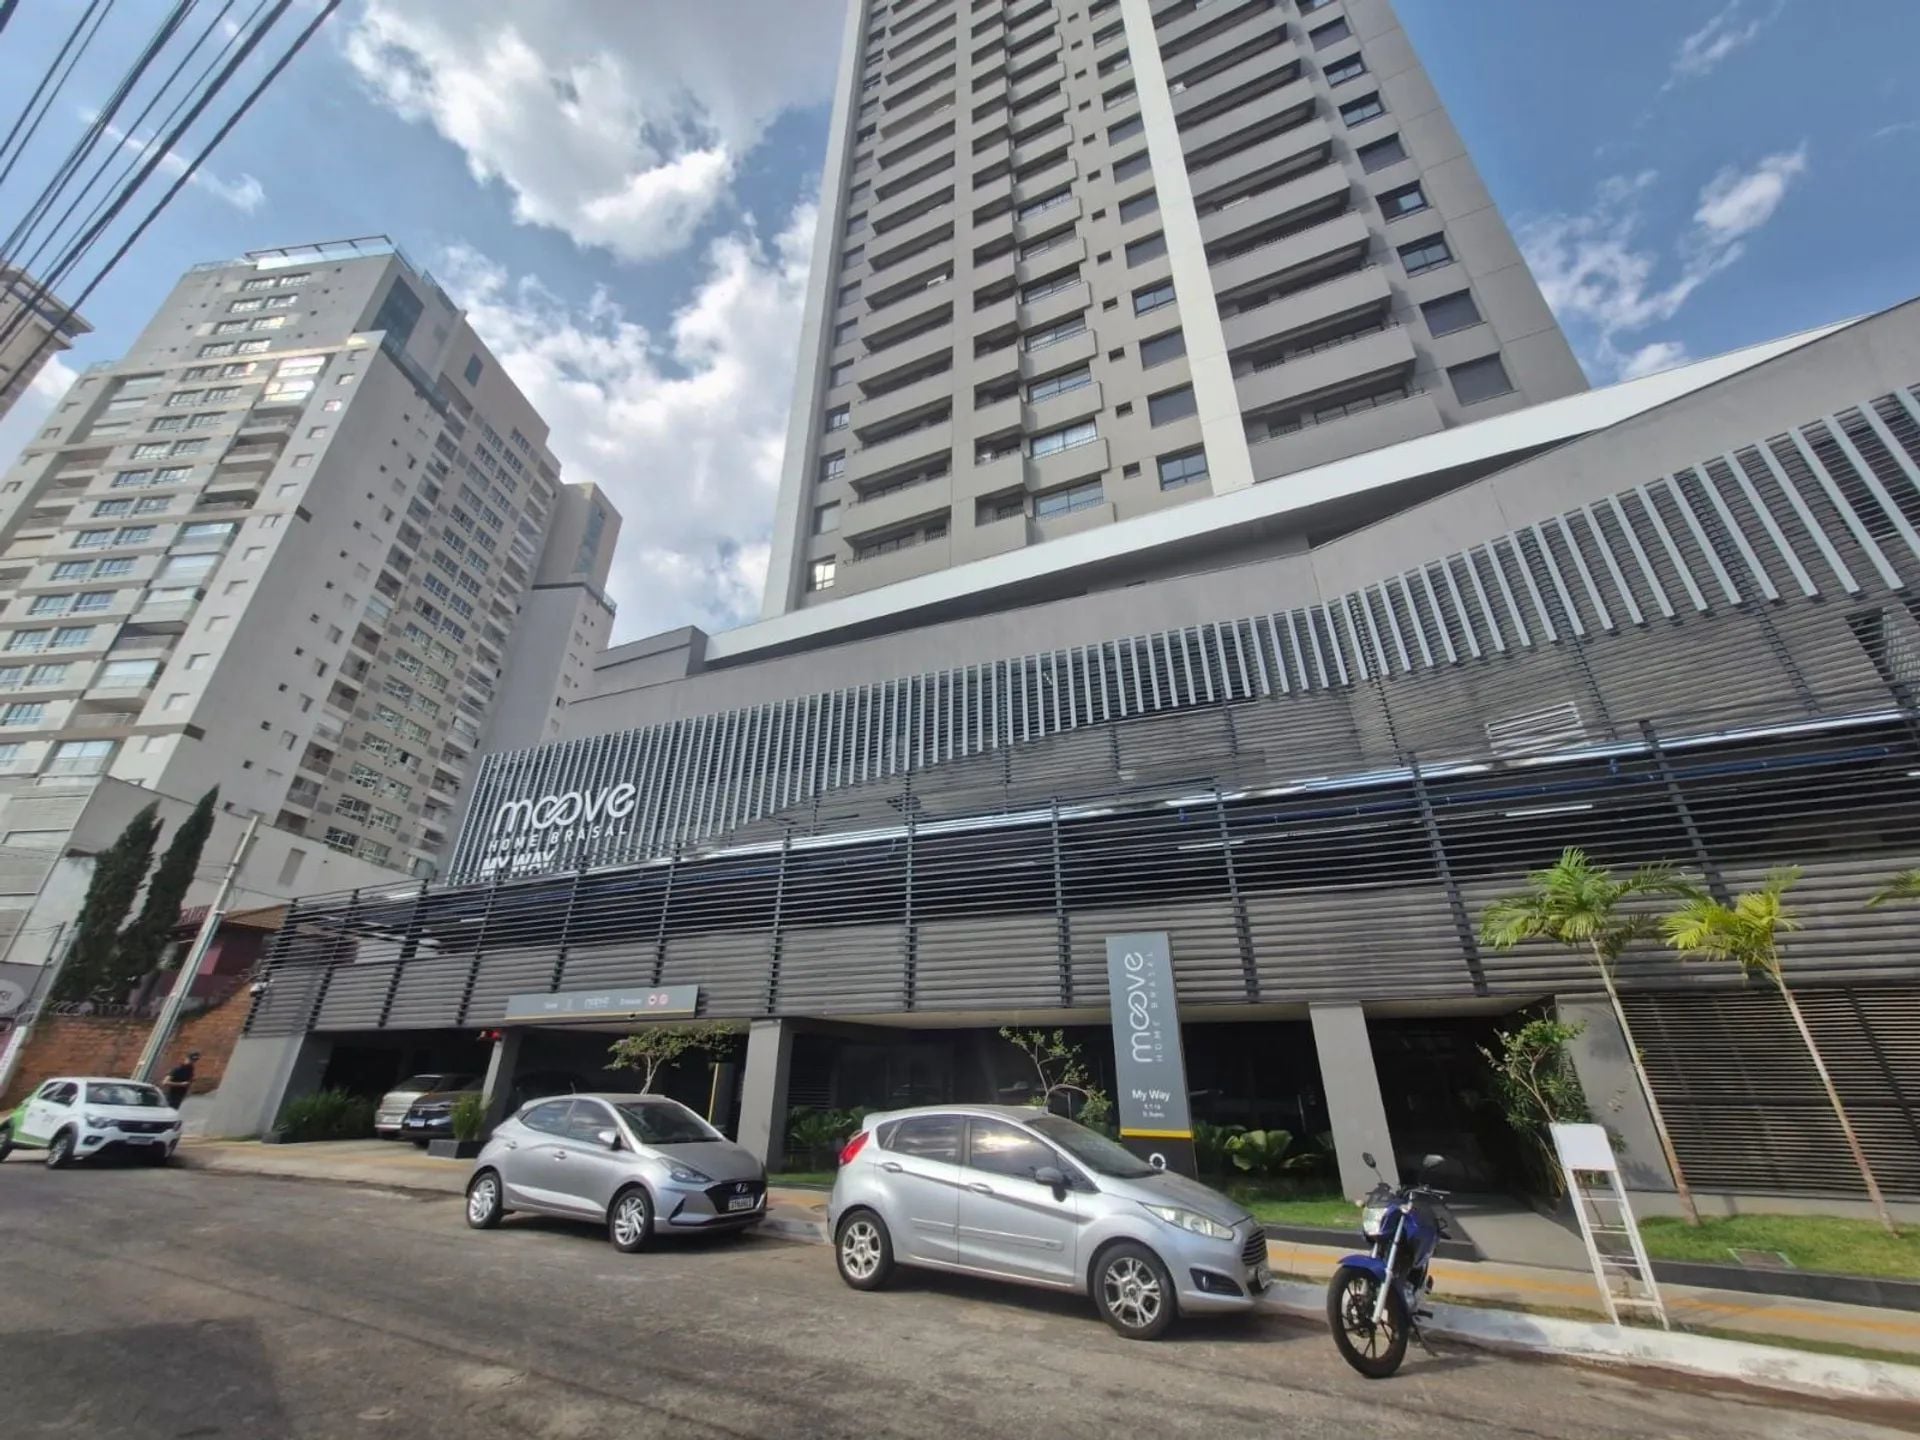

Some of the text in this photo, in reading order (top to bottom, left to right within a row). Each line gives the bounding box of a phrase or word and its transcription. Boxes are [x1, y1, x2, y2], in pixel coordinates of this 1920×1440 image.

[493, 783, 636, 834] moove
[550, 821, 627, 845] BRASAL
[1124, 951, 1153, 1063] moove
[1131, 1089, 1171, 1103] My Way
